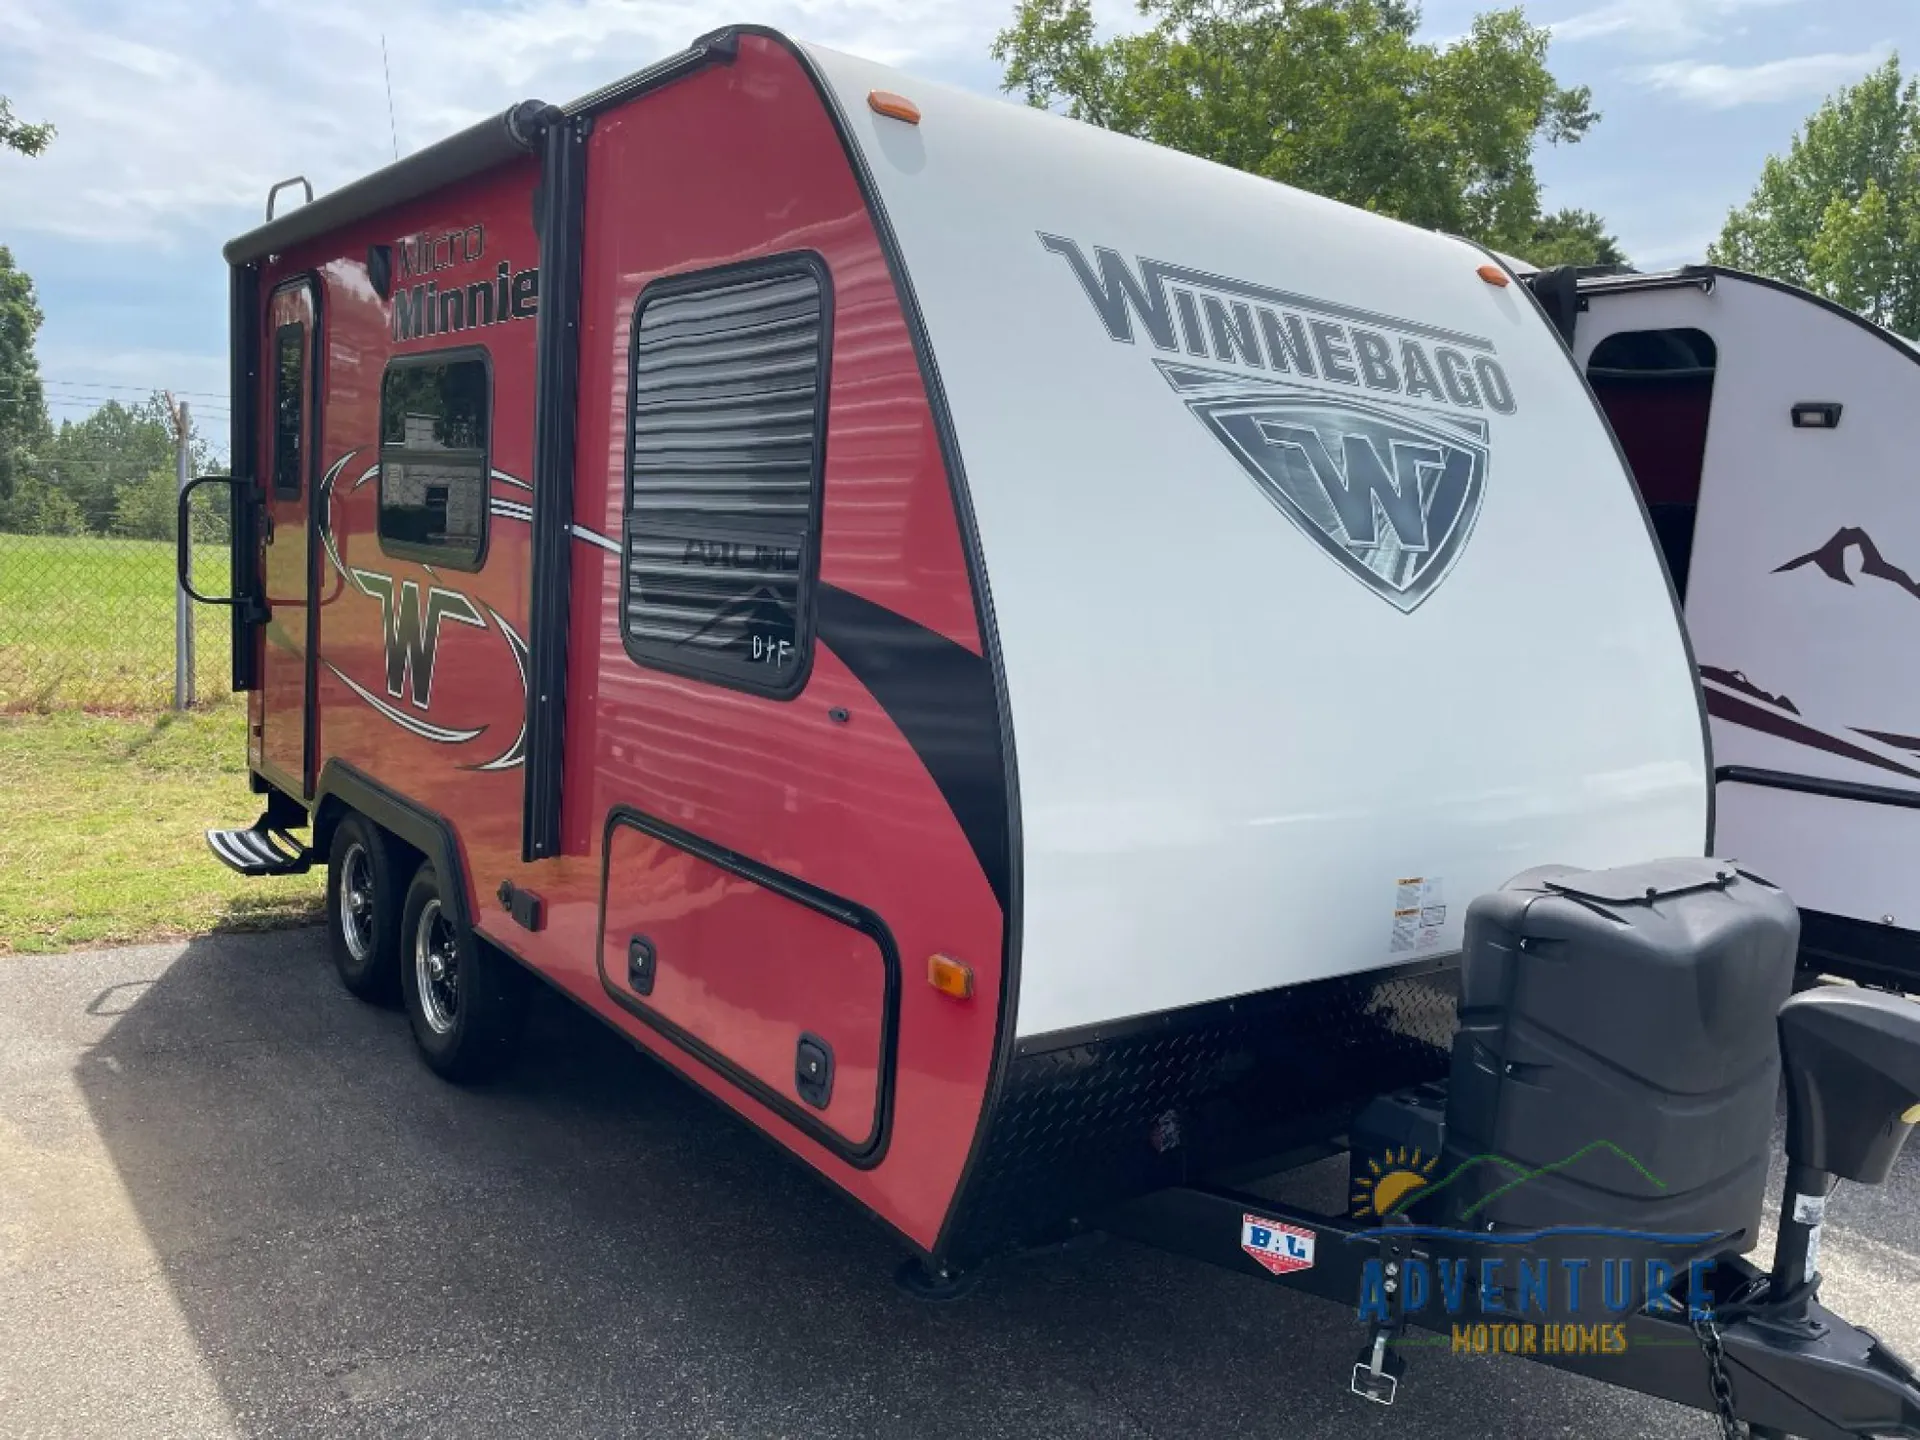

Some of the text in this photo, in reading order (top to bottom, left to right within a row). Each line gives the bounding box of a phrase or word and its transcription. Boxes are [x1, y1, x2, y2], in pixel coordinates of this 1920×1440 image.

[391, 260, 540, 343] Minnie
[394, 223, 485, 281] Micro
[1036, 231, 1517, 415] WINNEBAGO
[1253, 416, 1446, 552] W
[350, 567, 489, 711] W
